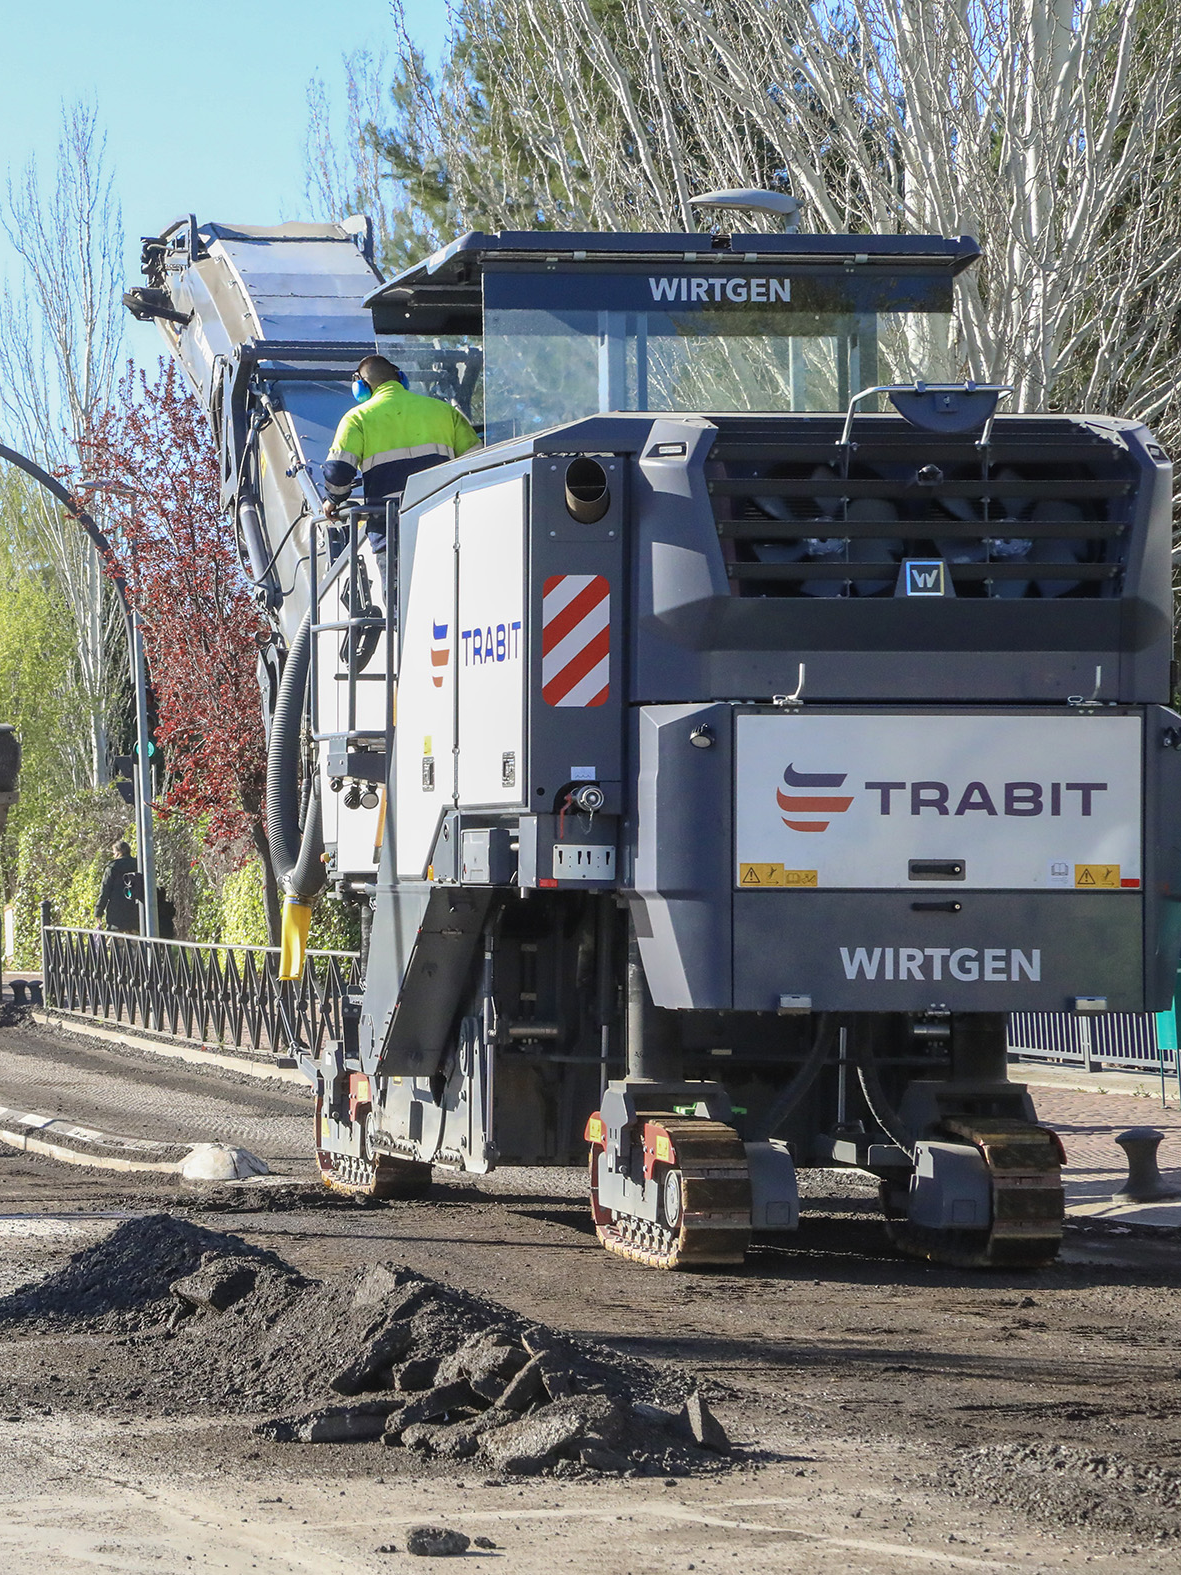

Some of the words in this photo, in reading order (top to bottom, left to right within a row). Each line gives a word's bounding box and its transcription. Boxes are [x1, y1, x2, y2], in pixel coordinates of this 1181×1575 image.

[648, 277, 791, 303] WIRTGEN
[461, 621, 522, 667] TRABIT
[864, 781, 1108, 817] TRABIT
[839, 947, 1041, 982] WIRTGEN
